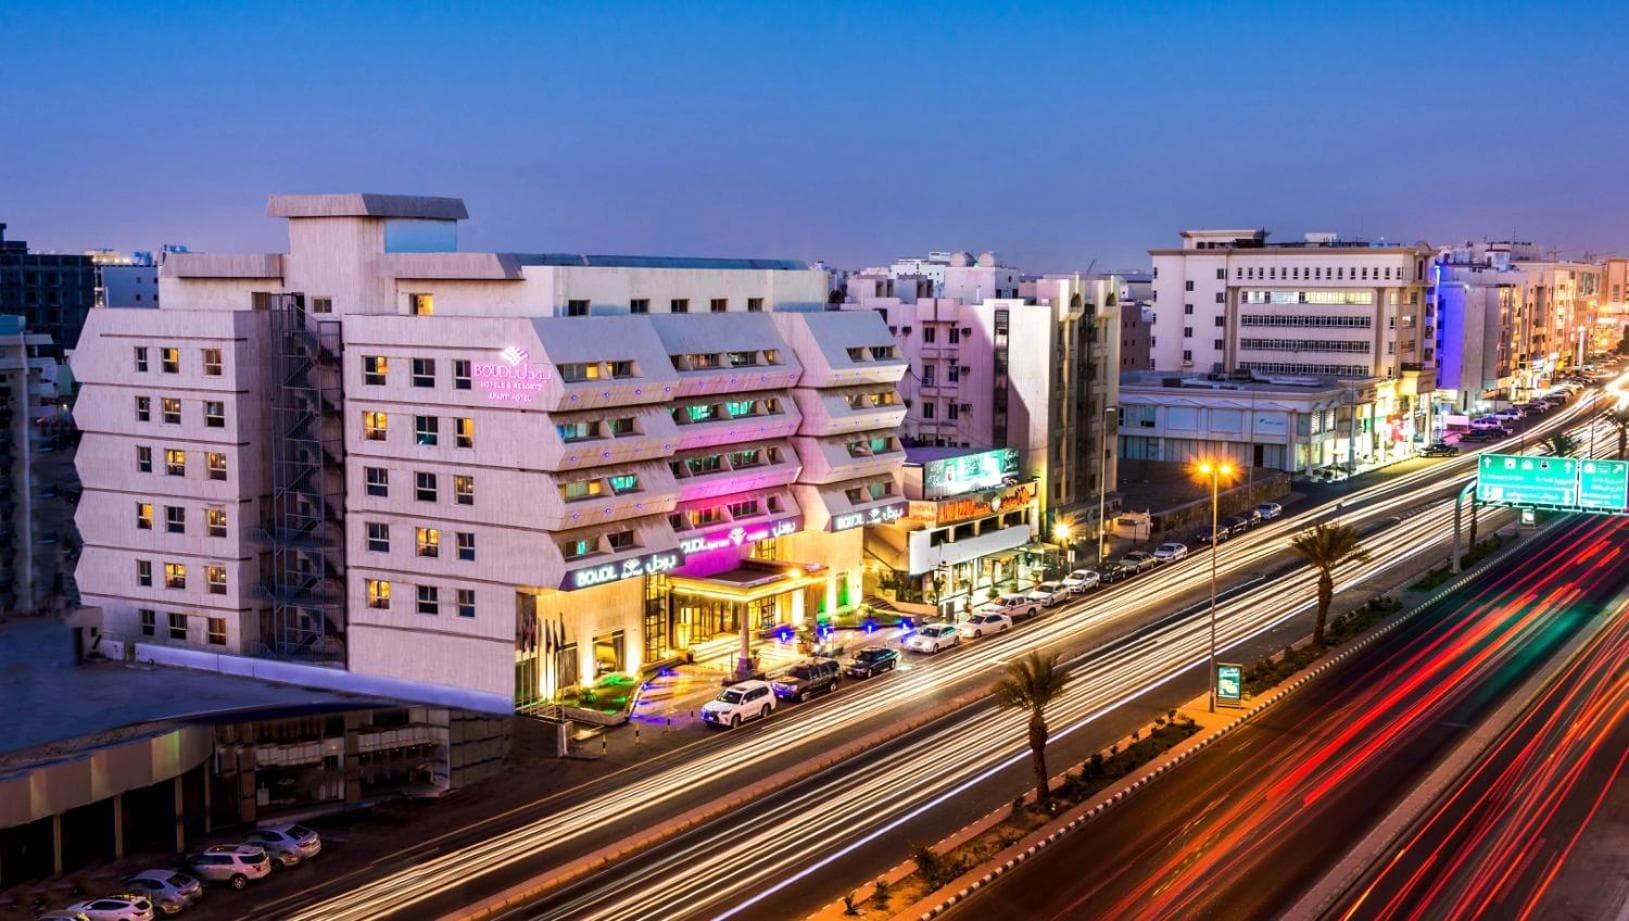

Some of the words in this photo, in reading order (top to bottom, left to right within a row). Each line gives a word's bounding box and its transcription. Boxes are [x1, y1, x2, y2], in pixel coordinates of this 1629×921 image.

[473, 365, 516, 378] BOUDL
[837, 513, 863, 529] BOUDL
[680, 538, 709, 553] OUDL
[576, 565, 618, 587] BOUDL
